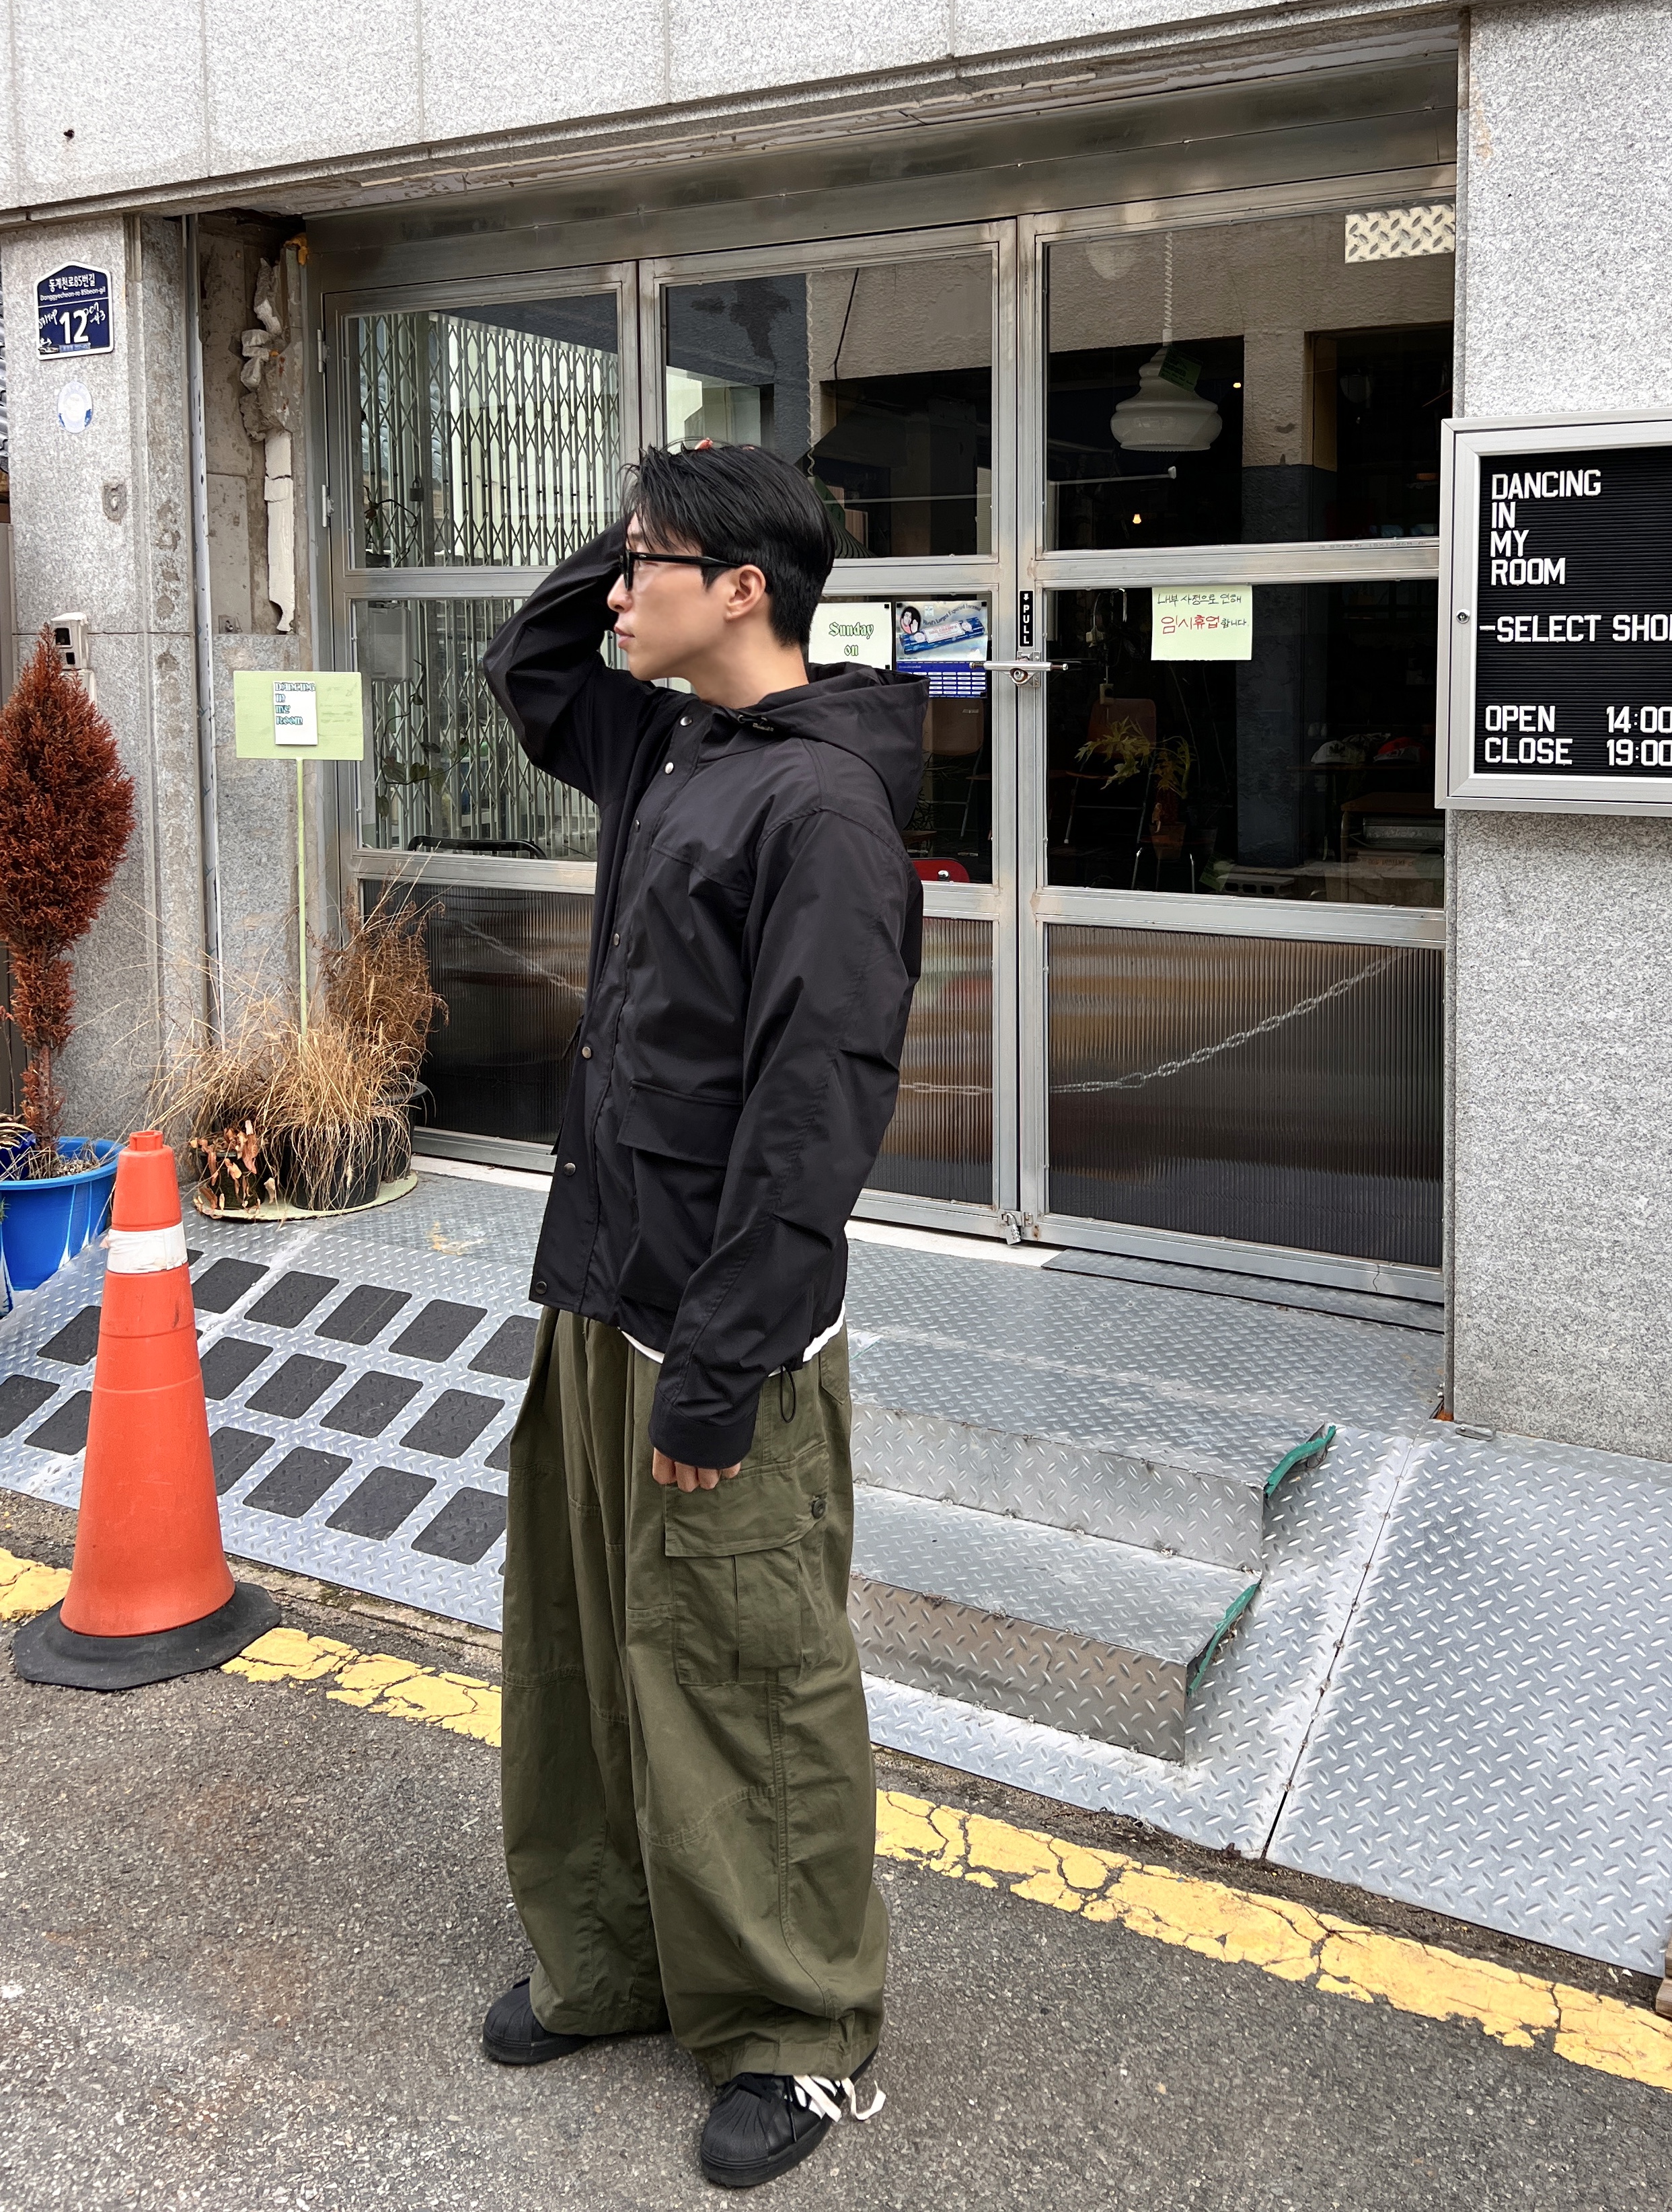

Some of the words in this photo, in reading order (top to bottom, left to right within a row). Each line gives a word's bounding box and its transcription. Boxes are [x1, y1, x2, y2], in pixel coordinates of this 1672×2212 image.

[49, 272, 96, 293] 동계천로85번길
[59, 310, 89, 344] 12
[1491, 469, 1602, 500] DANCING
[1491, 501, 1517, 529] IN
[1490, 529, 1529, 558] MY
[1490, 558, 1566, 586] ROOM
[1157, 593, 1178, 607] 내부
[1180, 593, 1219, 605] 사정으로
[828, 622, 874, 640] Sunday
[1022, 604, 1030, 644] PULL
[1612, 614, 1672, 642] SHO
[844, 644, 859, 657] on
[1485, 705, 1556, 732] OPEN
[1606, 706, 1672, 734] 14:00
[1484, 737, 1574, 766] CLOSE
[1606, 738, 1672, 767] 19:00
